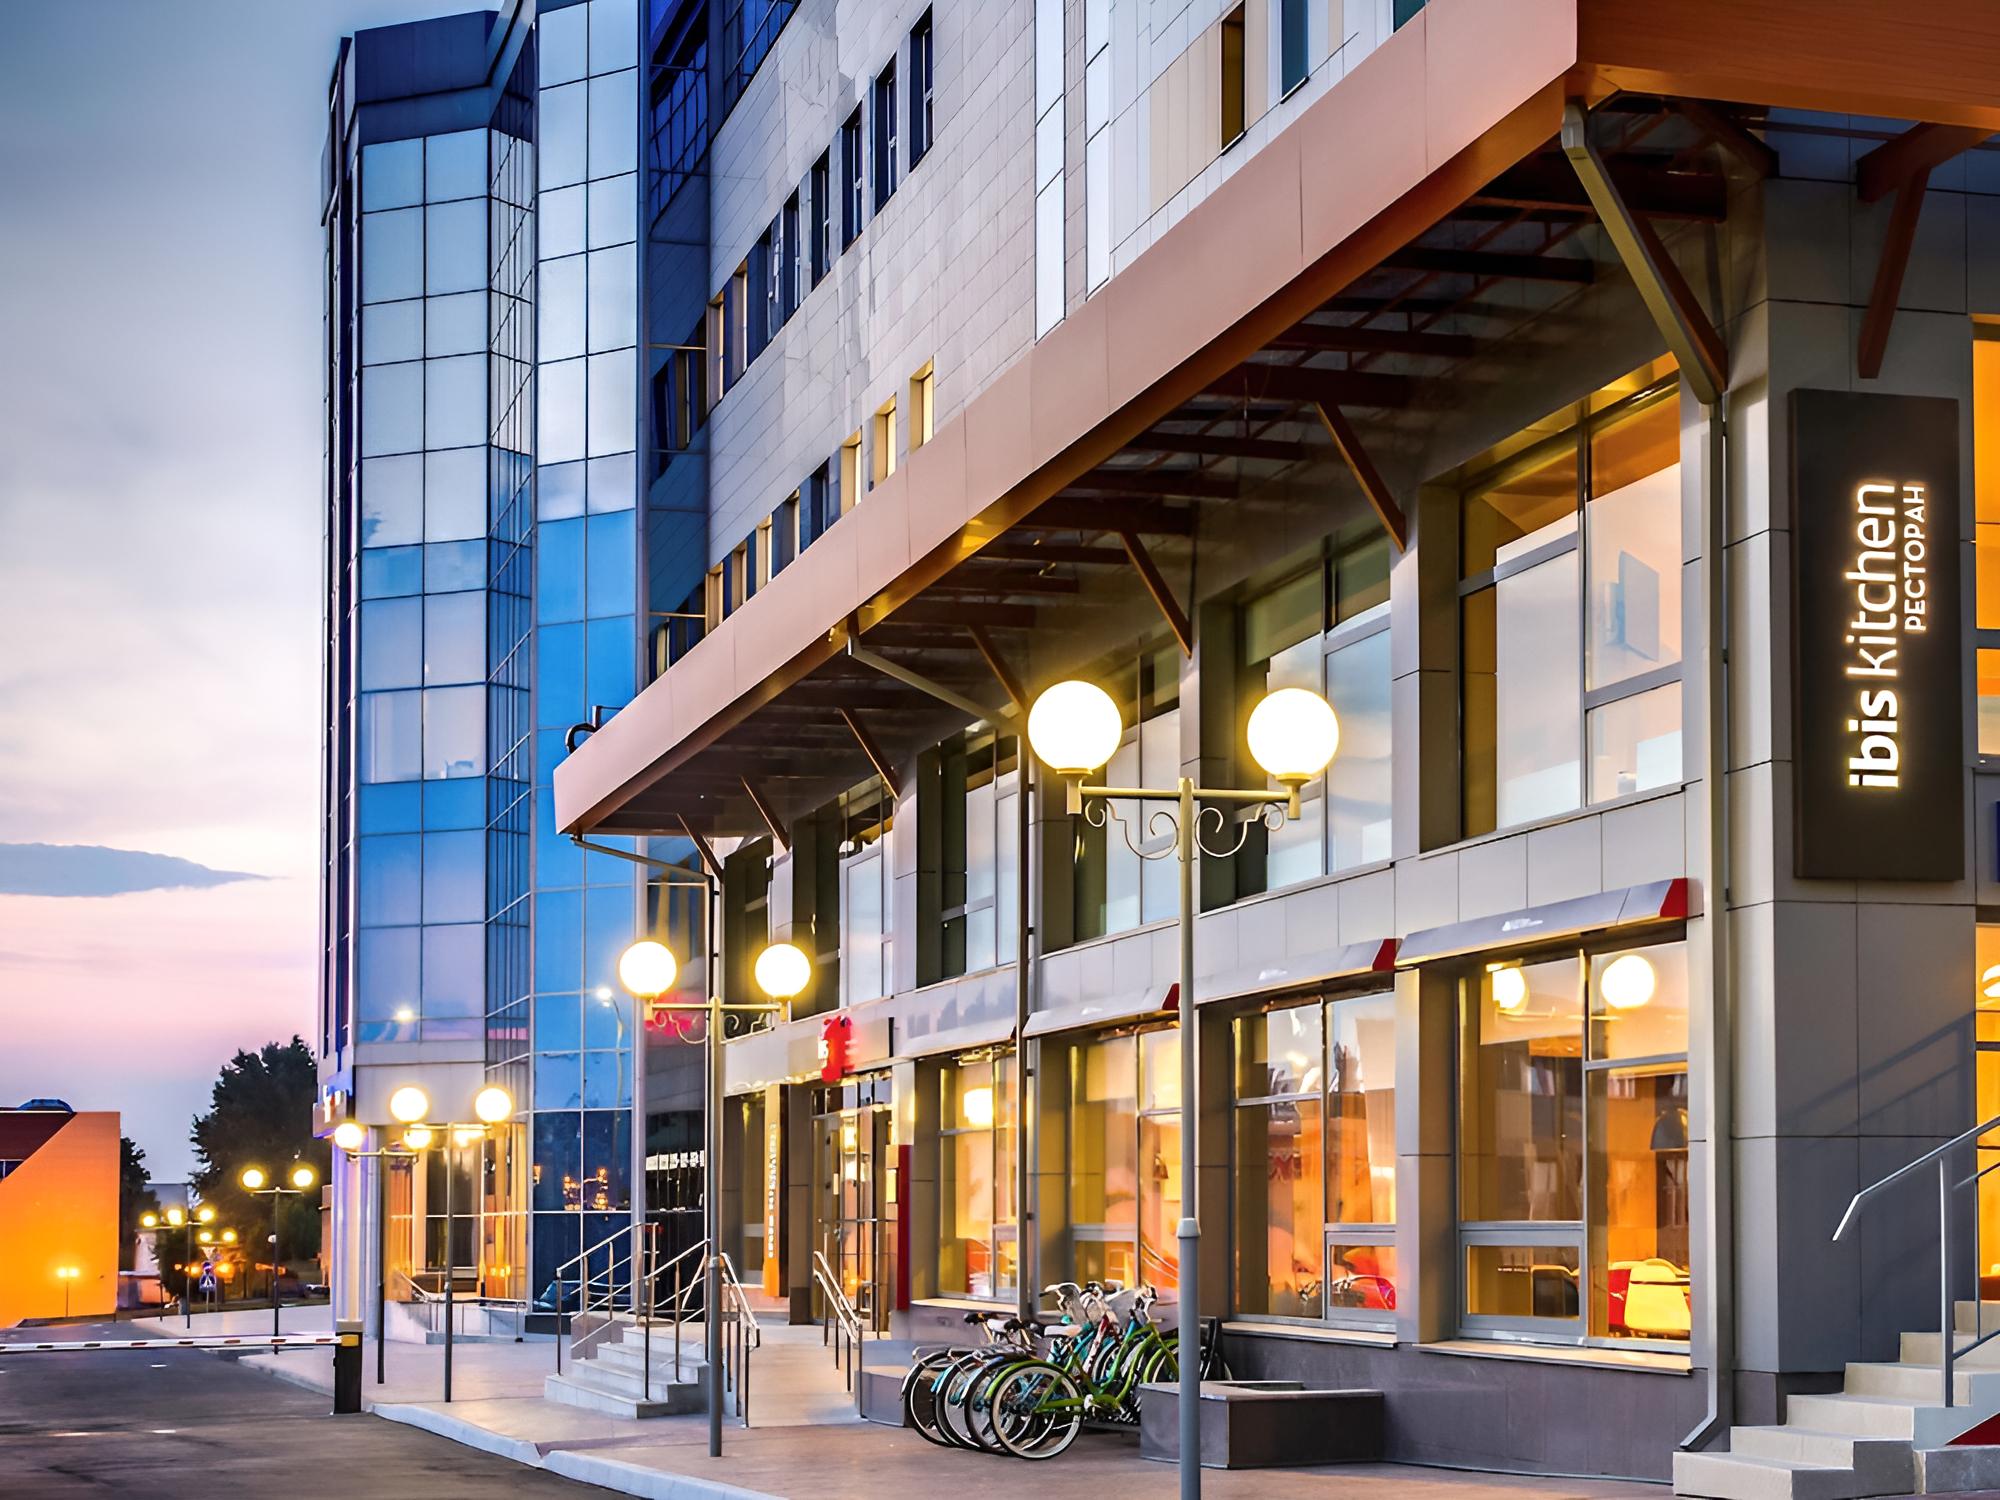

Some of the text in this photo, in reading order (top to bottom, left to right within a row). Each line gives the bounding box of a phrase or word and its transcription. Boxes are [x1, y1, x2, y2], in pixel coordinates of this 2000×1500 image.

[1846, 484, 1899, 788] ibis kitchen
[1903, 486, 1927, 632] РЕСТОРАН
